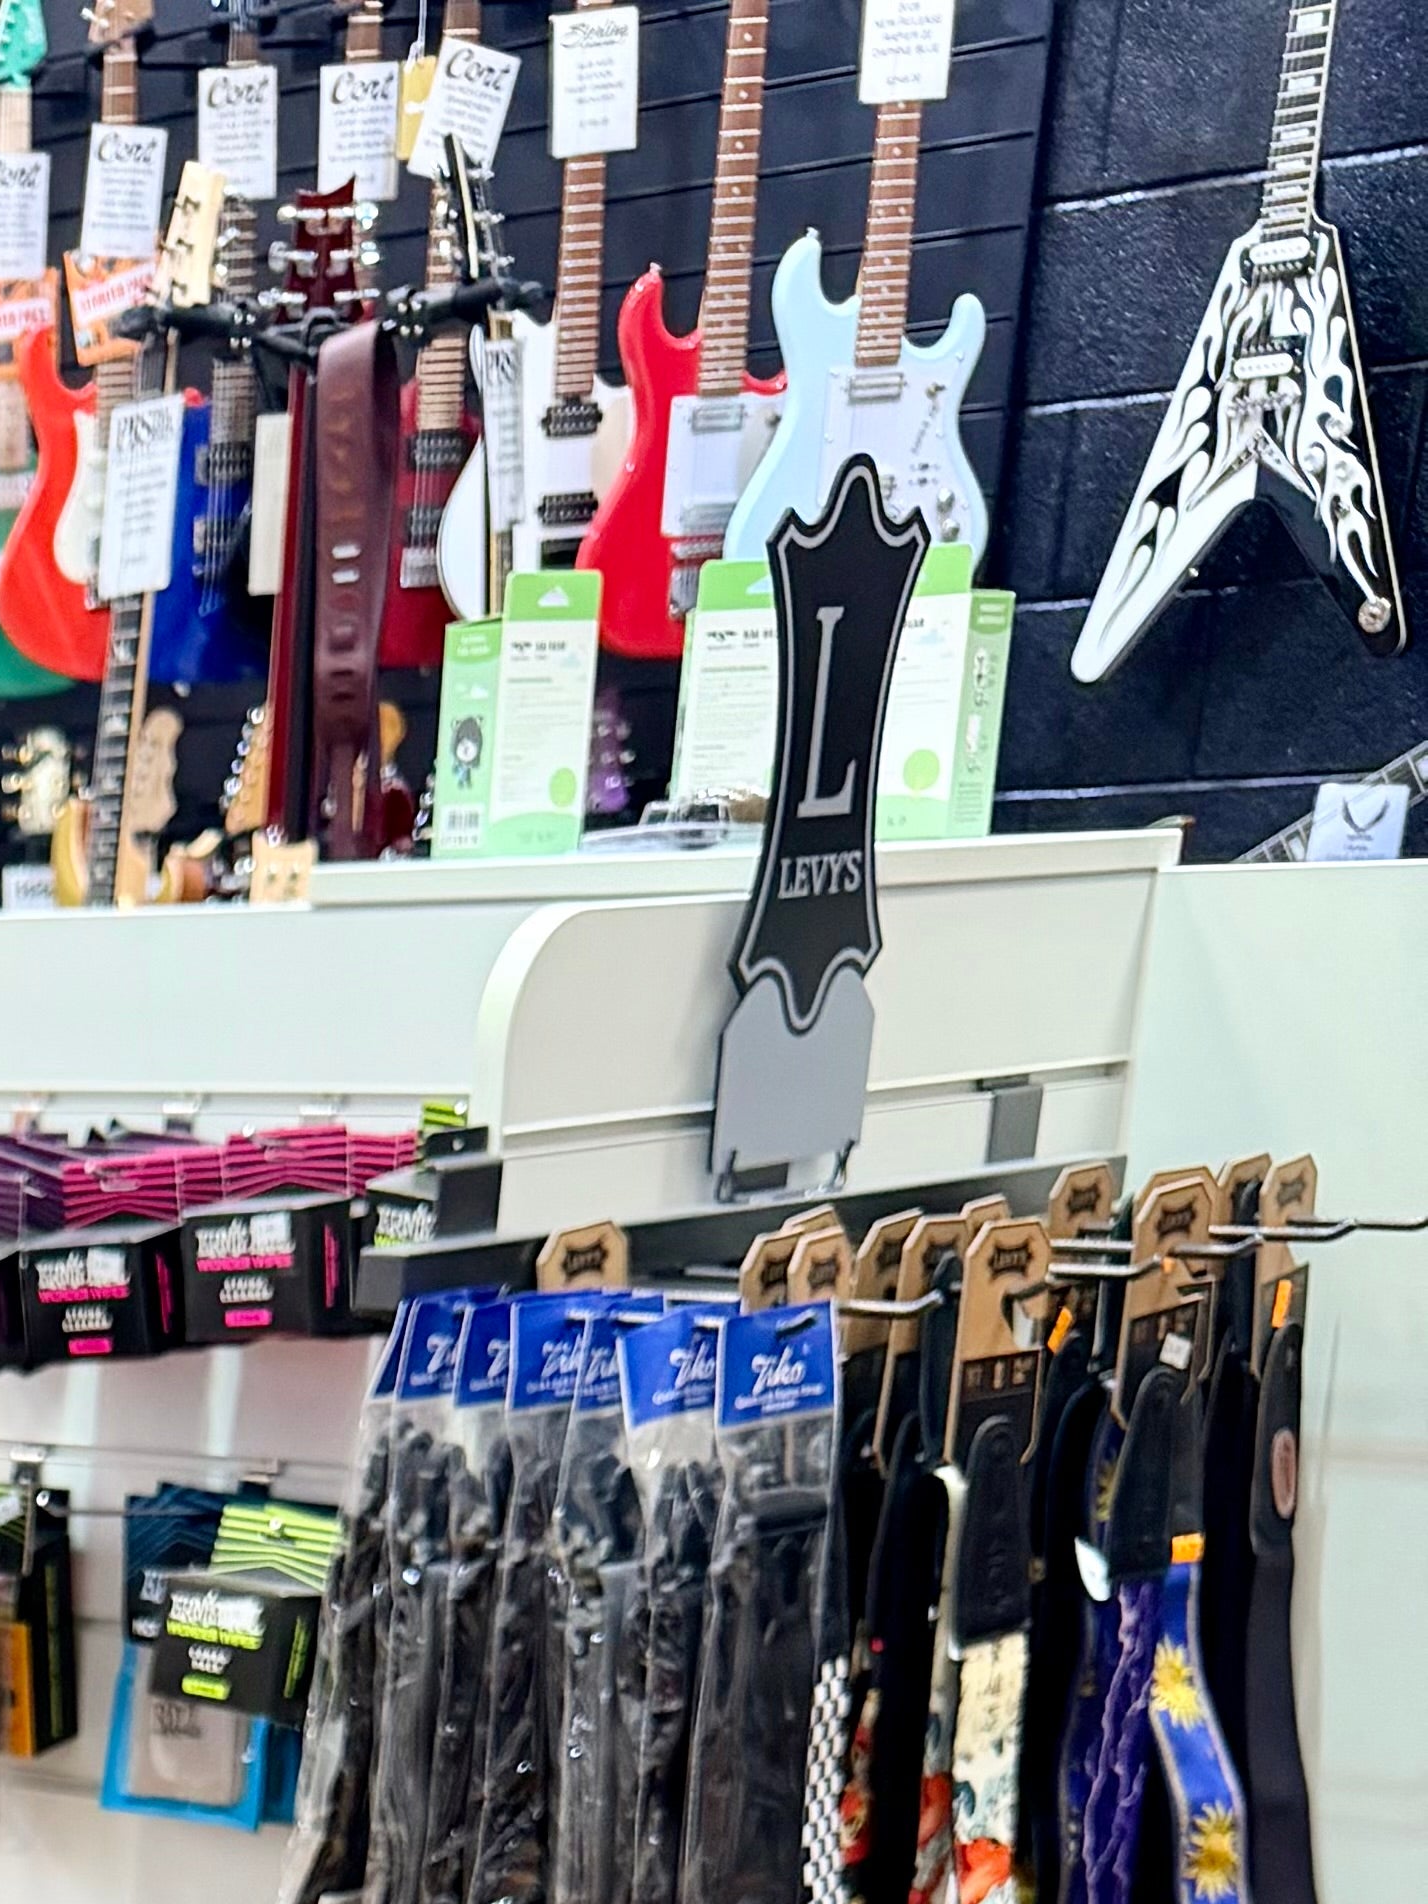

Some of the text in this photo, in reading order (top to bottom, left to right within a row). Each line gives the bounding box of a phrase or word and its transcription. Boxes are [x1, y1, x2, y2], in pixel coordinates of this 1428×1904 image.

[445, 48, 510, 91] Cort
[208, 76, 269, 108] Cort
[332, 72, 394, 105] Cort
